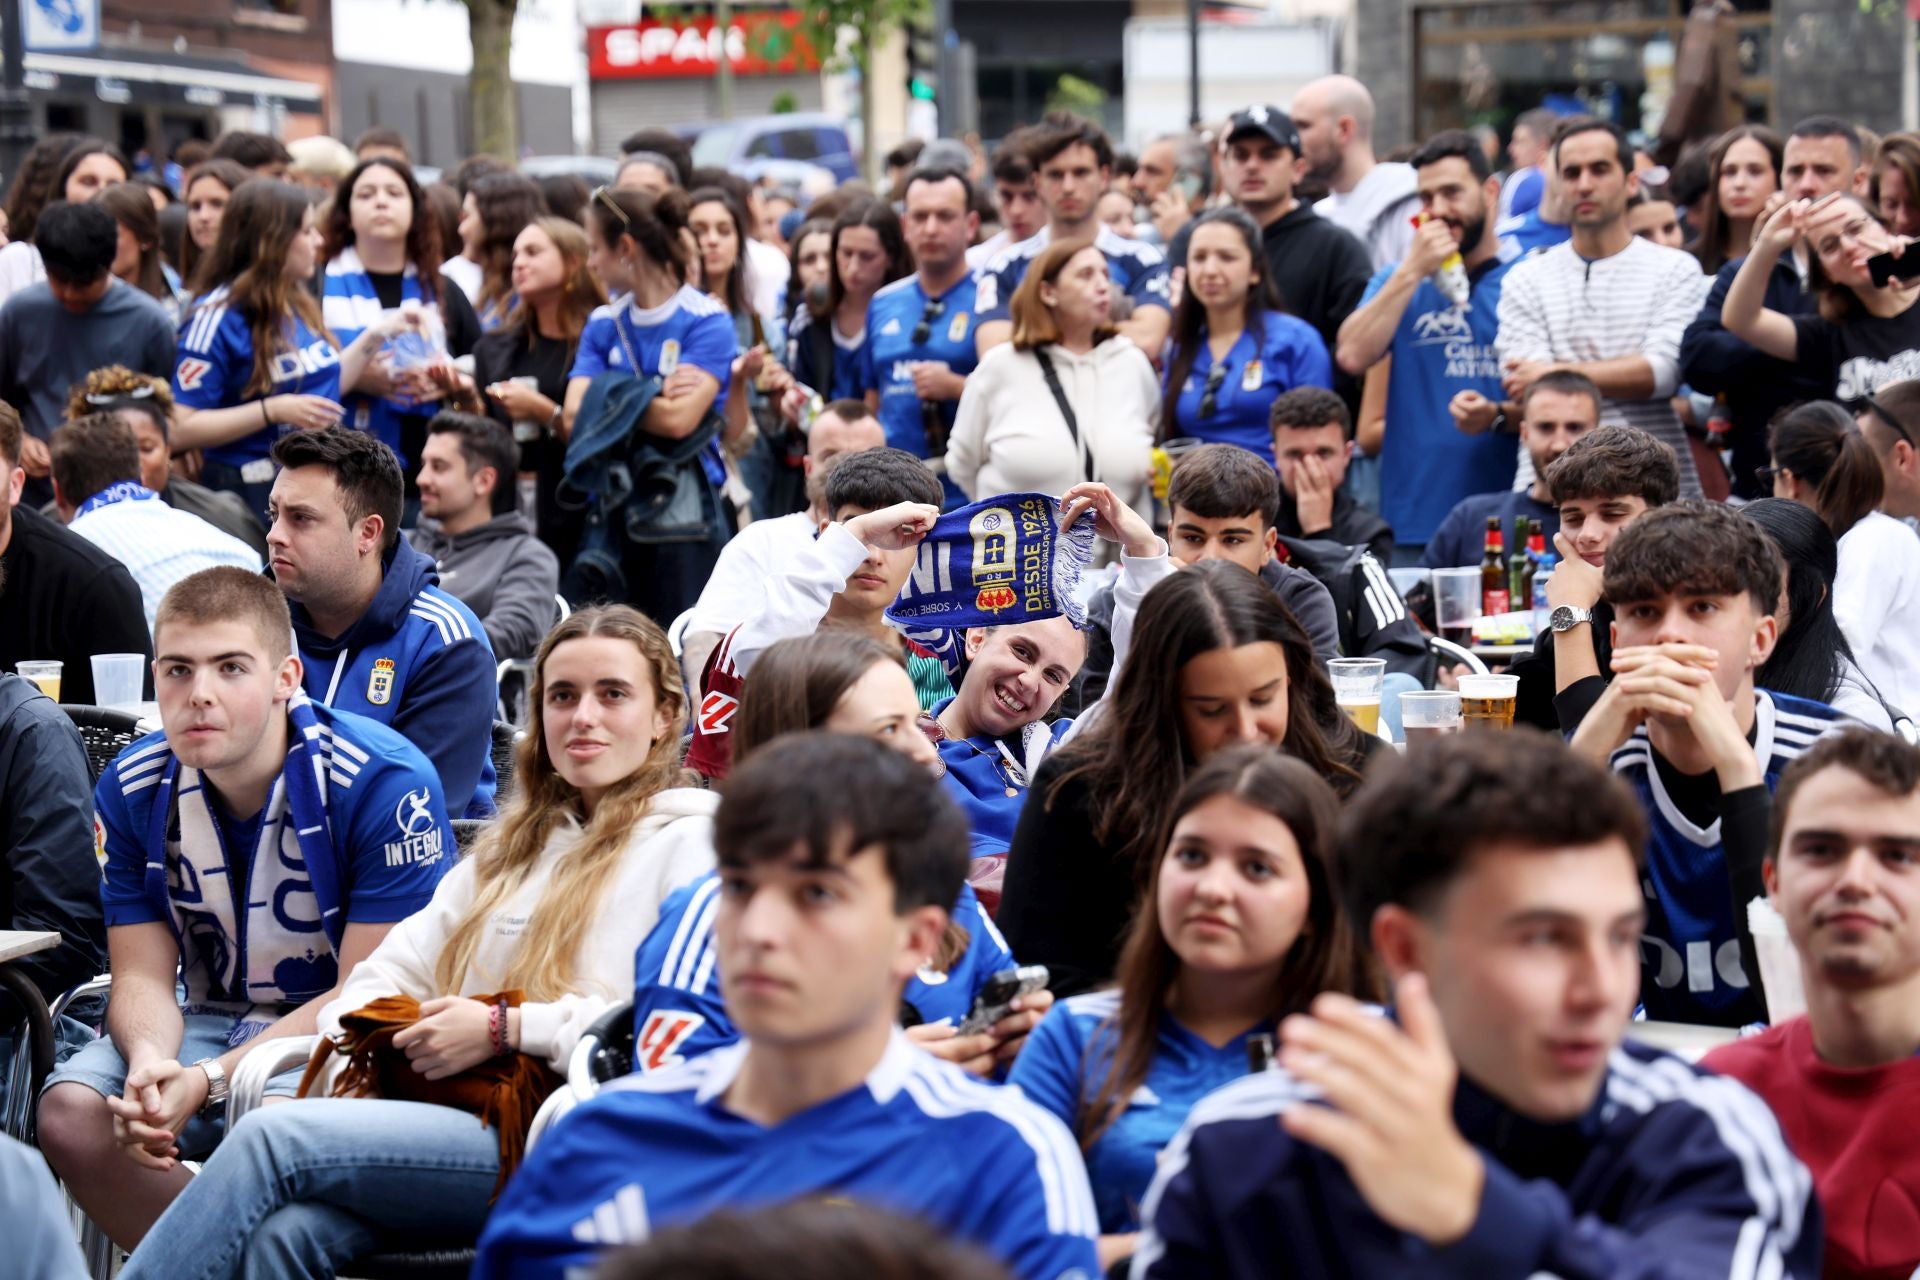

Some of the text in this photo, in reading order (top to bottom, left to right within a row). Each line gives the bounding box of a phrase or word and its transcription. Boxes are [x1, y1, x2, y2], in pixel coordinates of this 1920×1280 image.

[606, 25, 746, 66] SPAR
[1018, 500, 1043, 612] DESDE 1926
[920, 602, 950, 615] SOBRE
